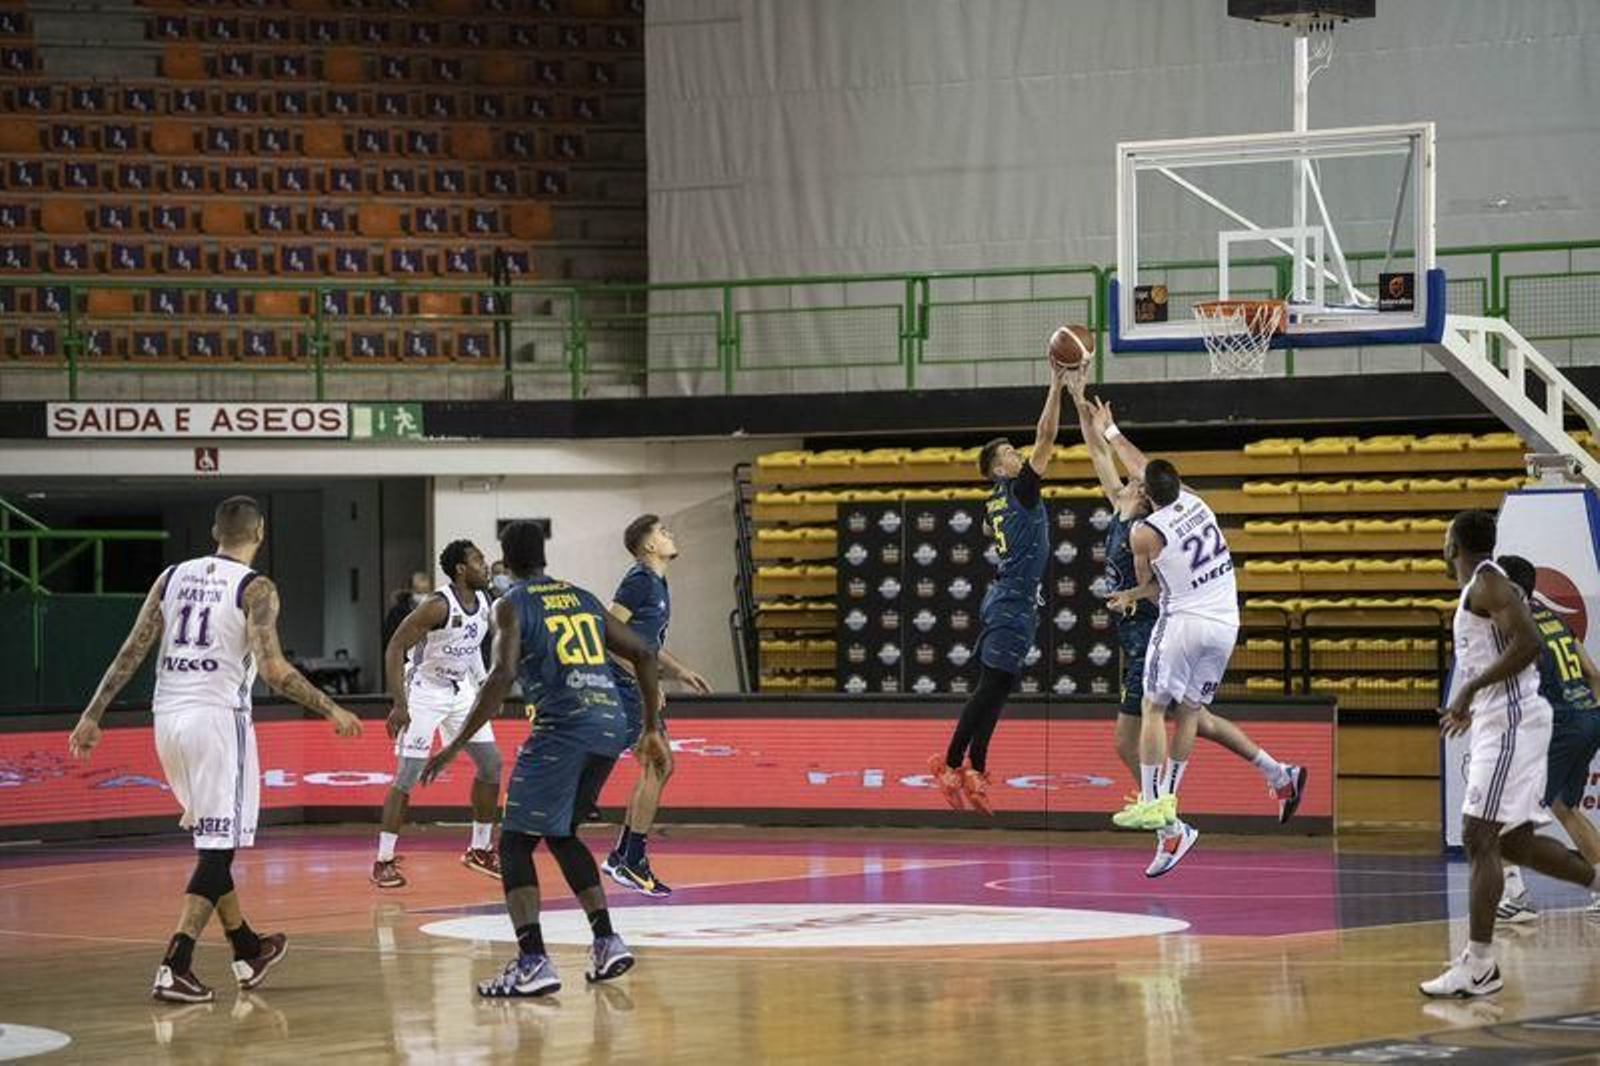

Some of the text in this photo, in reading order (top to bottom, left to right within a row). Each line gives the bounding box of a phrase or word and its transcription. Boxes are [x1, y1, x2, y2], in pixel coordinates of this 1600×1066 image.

[54, 408, 341, 431] SAIDA E ASEOS
[1182, 523, 1228, 572] 22
[174, 604, 212, 648] 11
[543, 612, 605, 667] 20
[1547, 636, 1583, 682] 15
